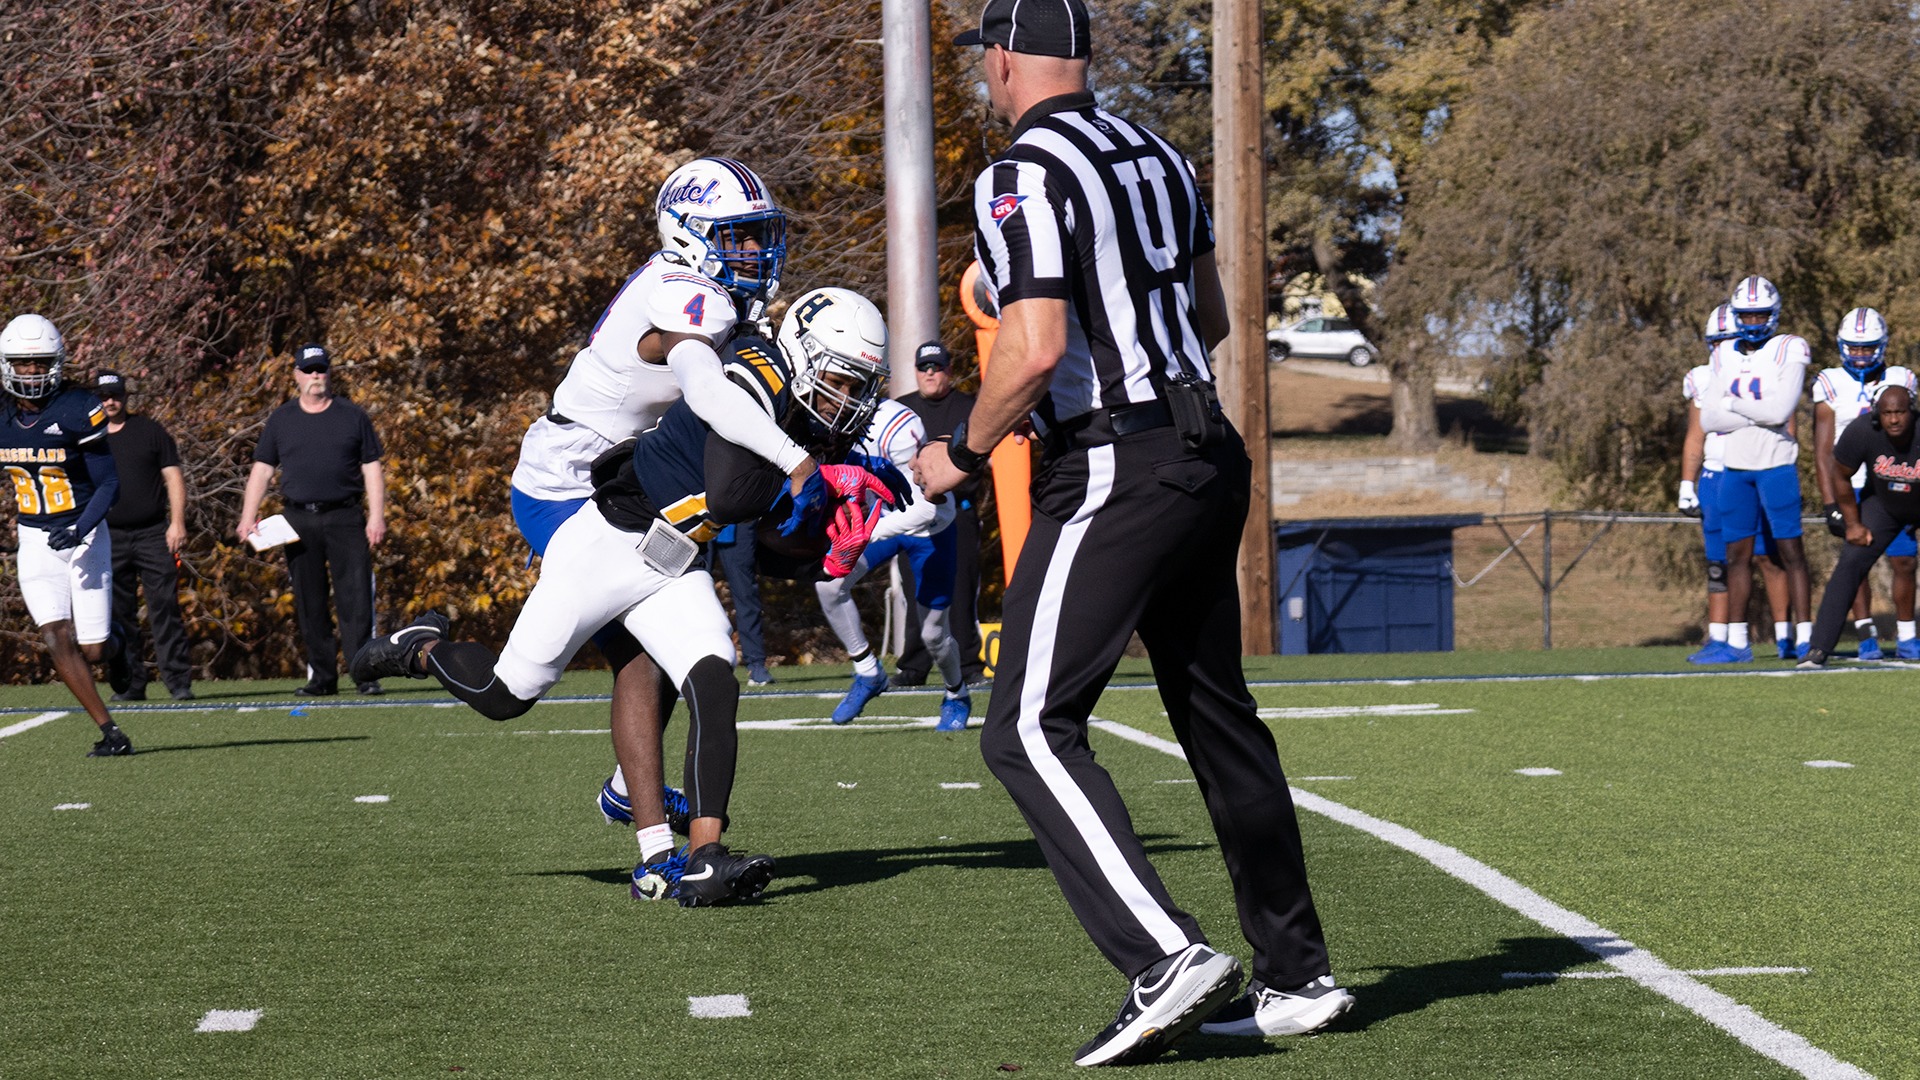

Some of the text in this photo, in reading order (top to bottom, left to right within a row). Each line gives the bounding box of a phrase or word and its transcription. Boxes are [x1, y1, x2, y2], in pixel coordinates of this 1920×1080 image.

[1111, 155, 1179, 273] U
[682, 292, 706, 327] 4
[794, 291, 836, 327] H
[3, 465, 76, 515] 88
